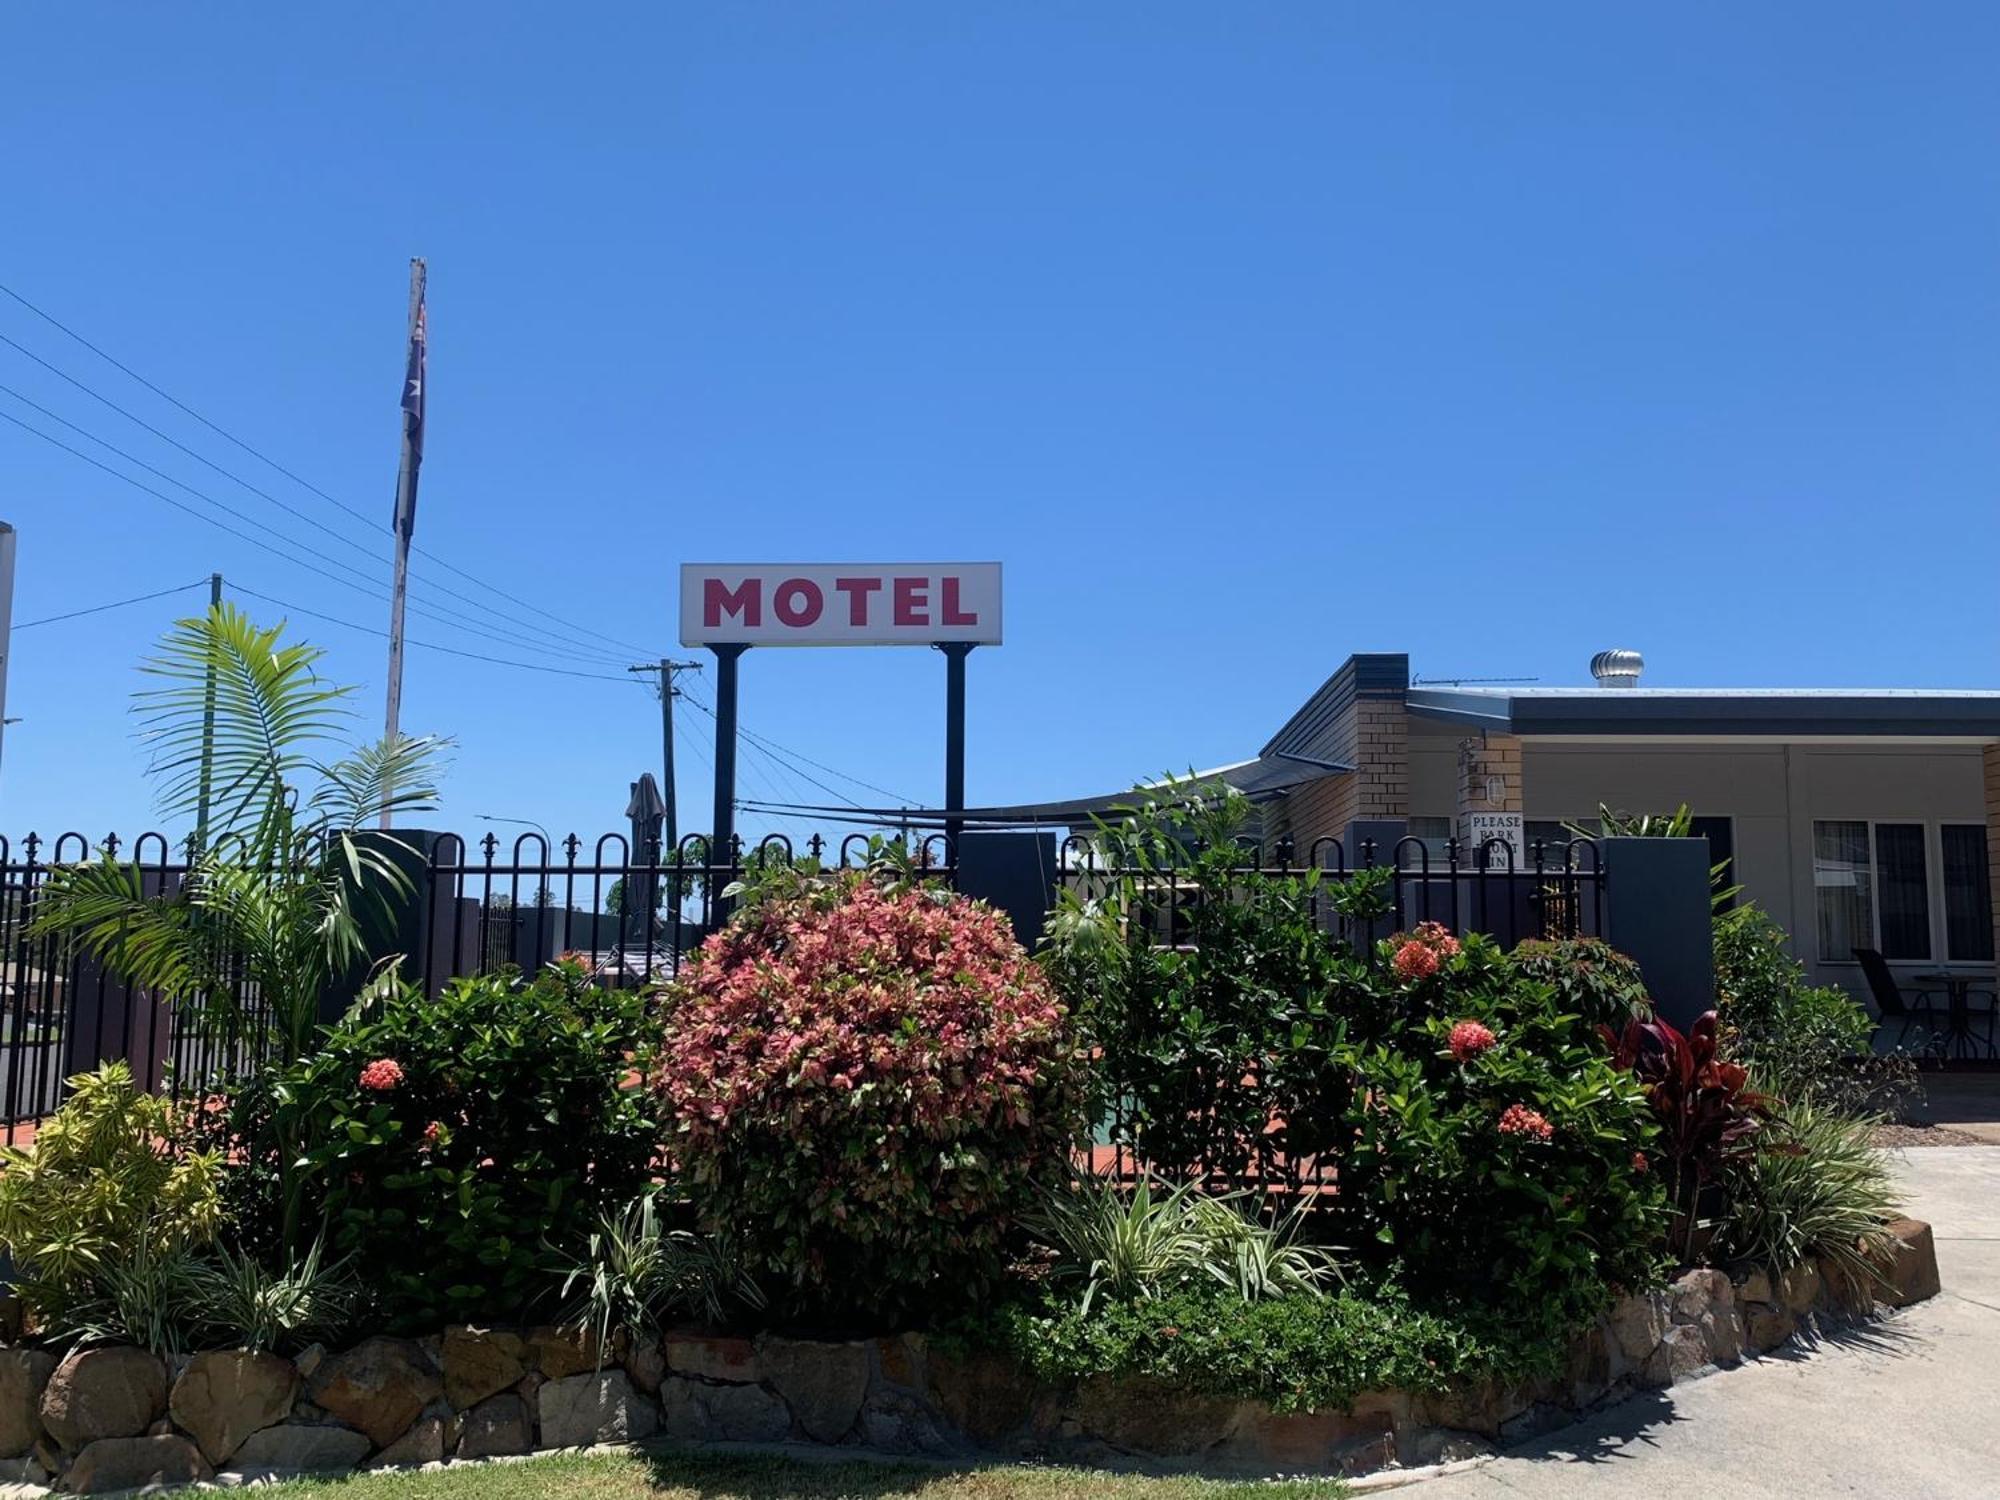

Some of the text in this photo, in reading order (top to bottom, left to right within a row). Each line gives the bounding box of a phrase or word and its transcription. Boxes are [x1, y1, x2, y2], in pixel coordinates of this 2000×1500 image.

[704, 577, 978, 628] MOTEL
[1473, 817, 1521, 827] PLEASE
[1480, 830, 1515, 841] PARK
[1490, 857, 1506, 867] IN
